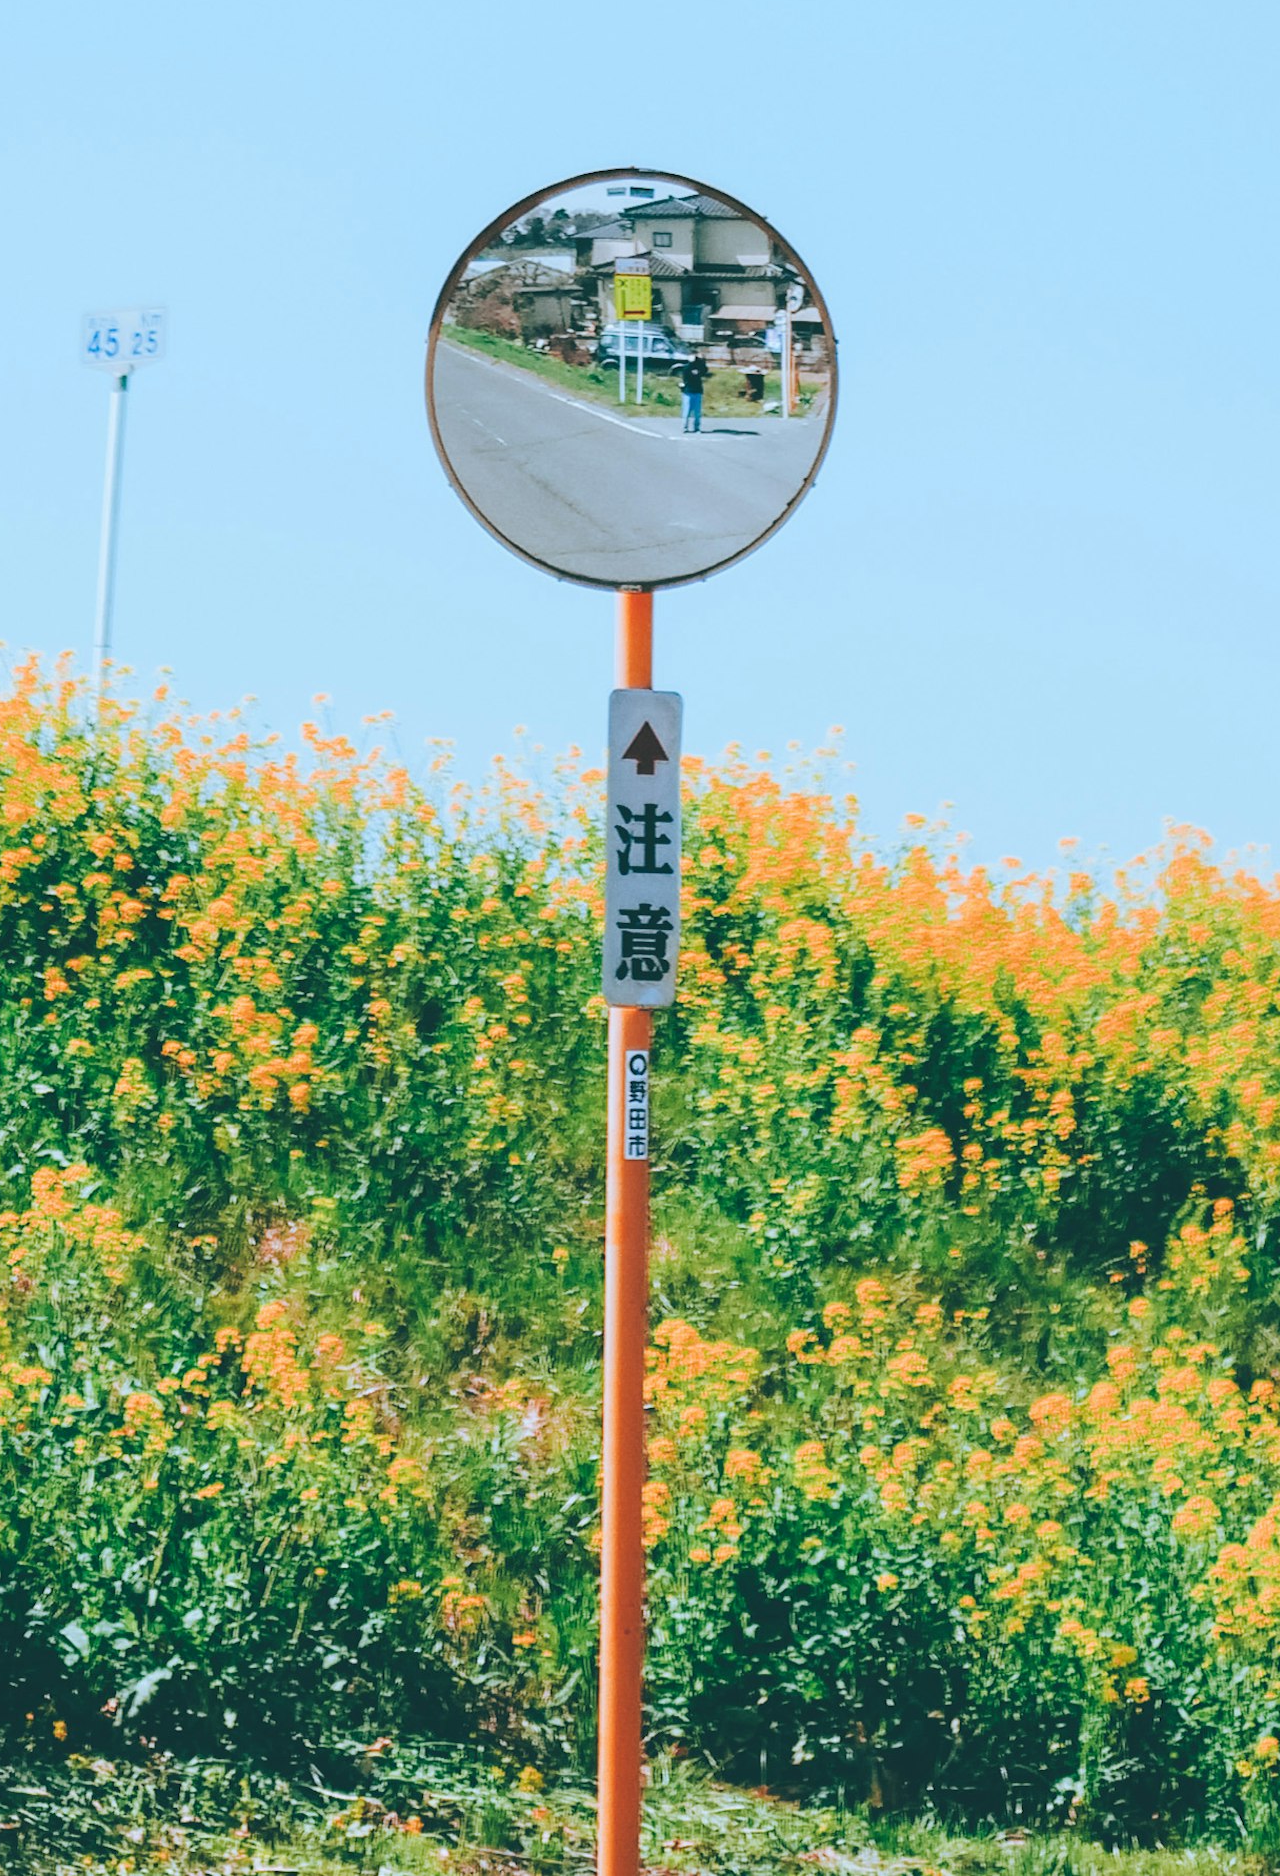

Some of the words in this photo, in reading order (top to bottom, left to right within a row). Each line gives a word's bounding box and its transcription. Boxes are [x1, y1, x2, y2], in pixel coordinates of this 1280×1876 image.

[615, 804, 674, 981] 注意
[628, 1080, 646, 1157] 野田市
